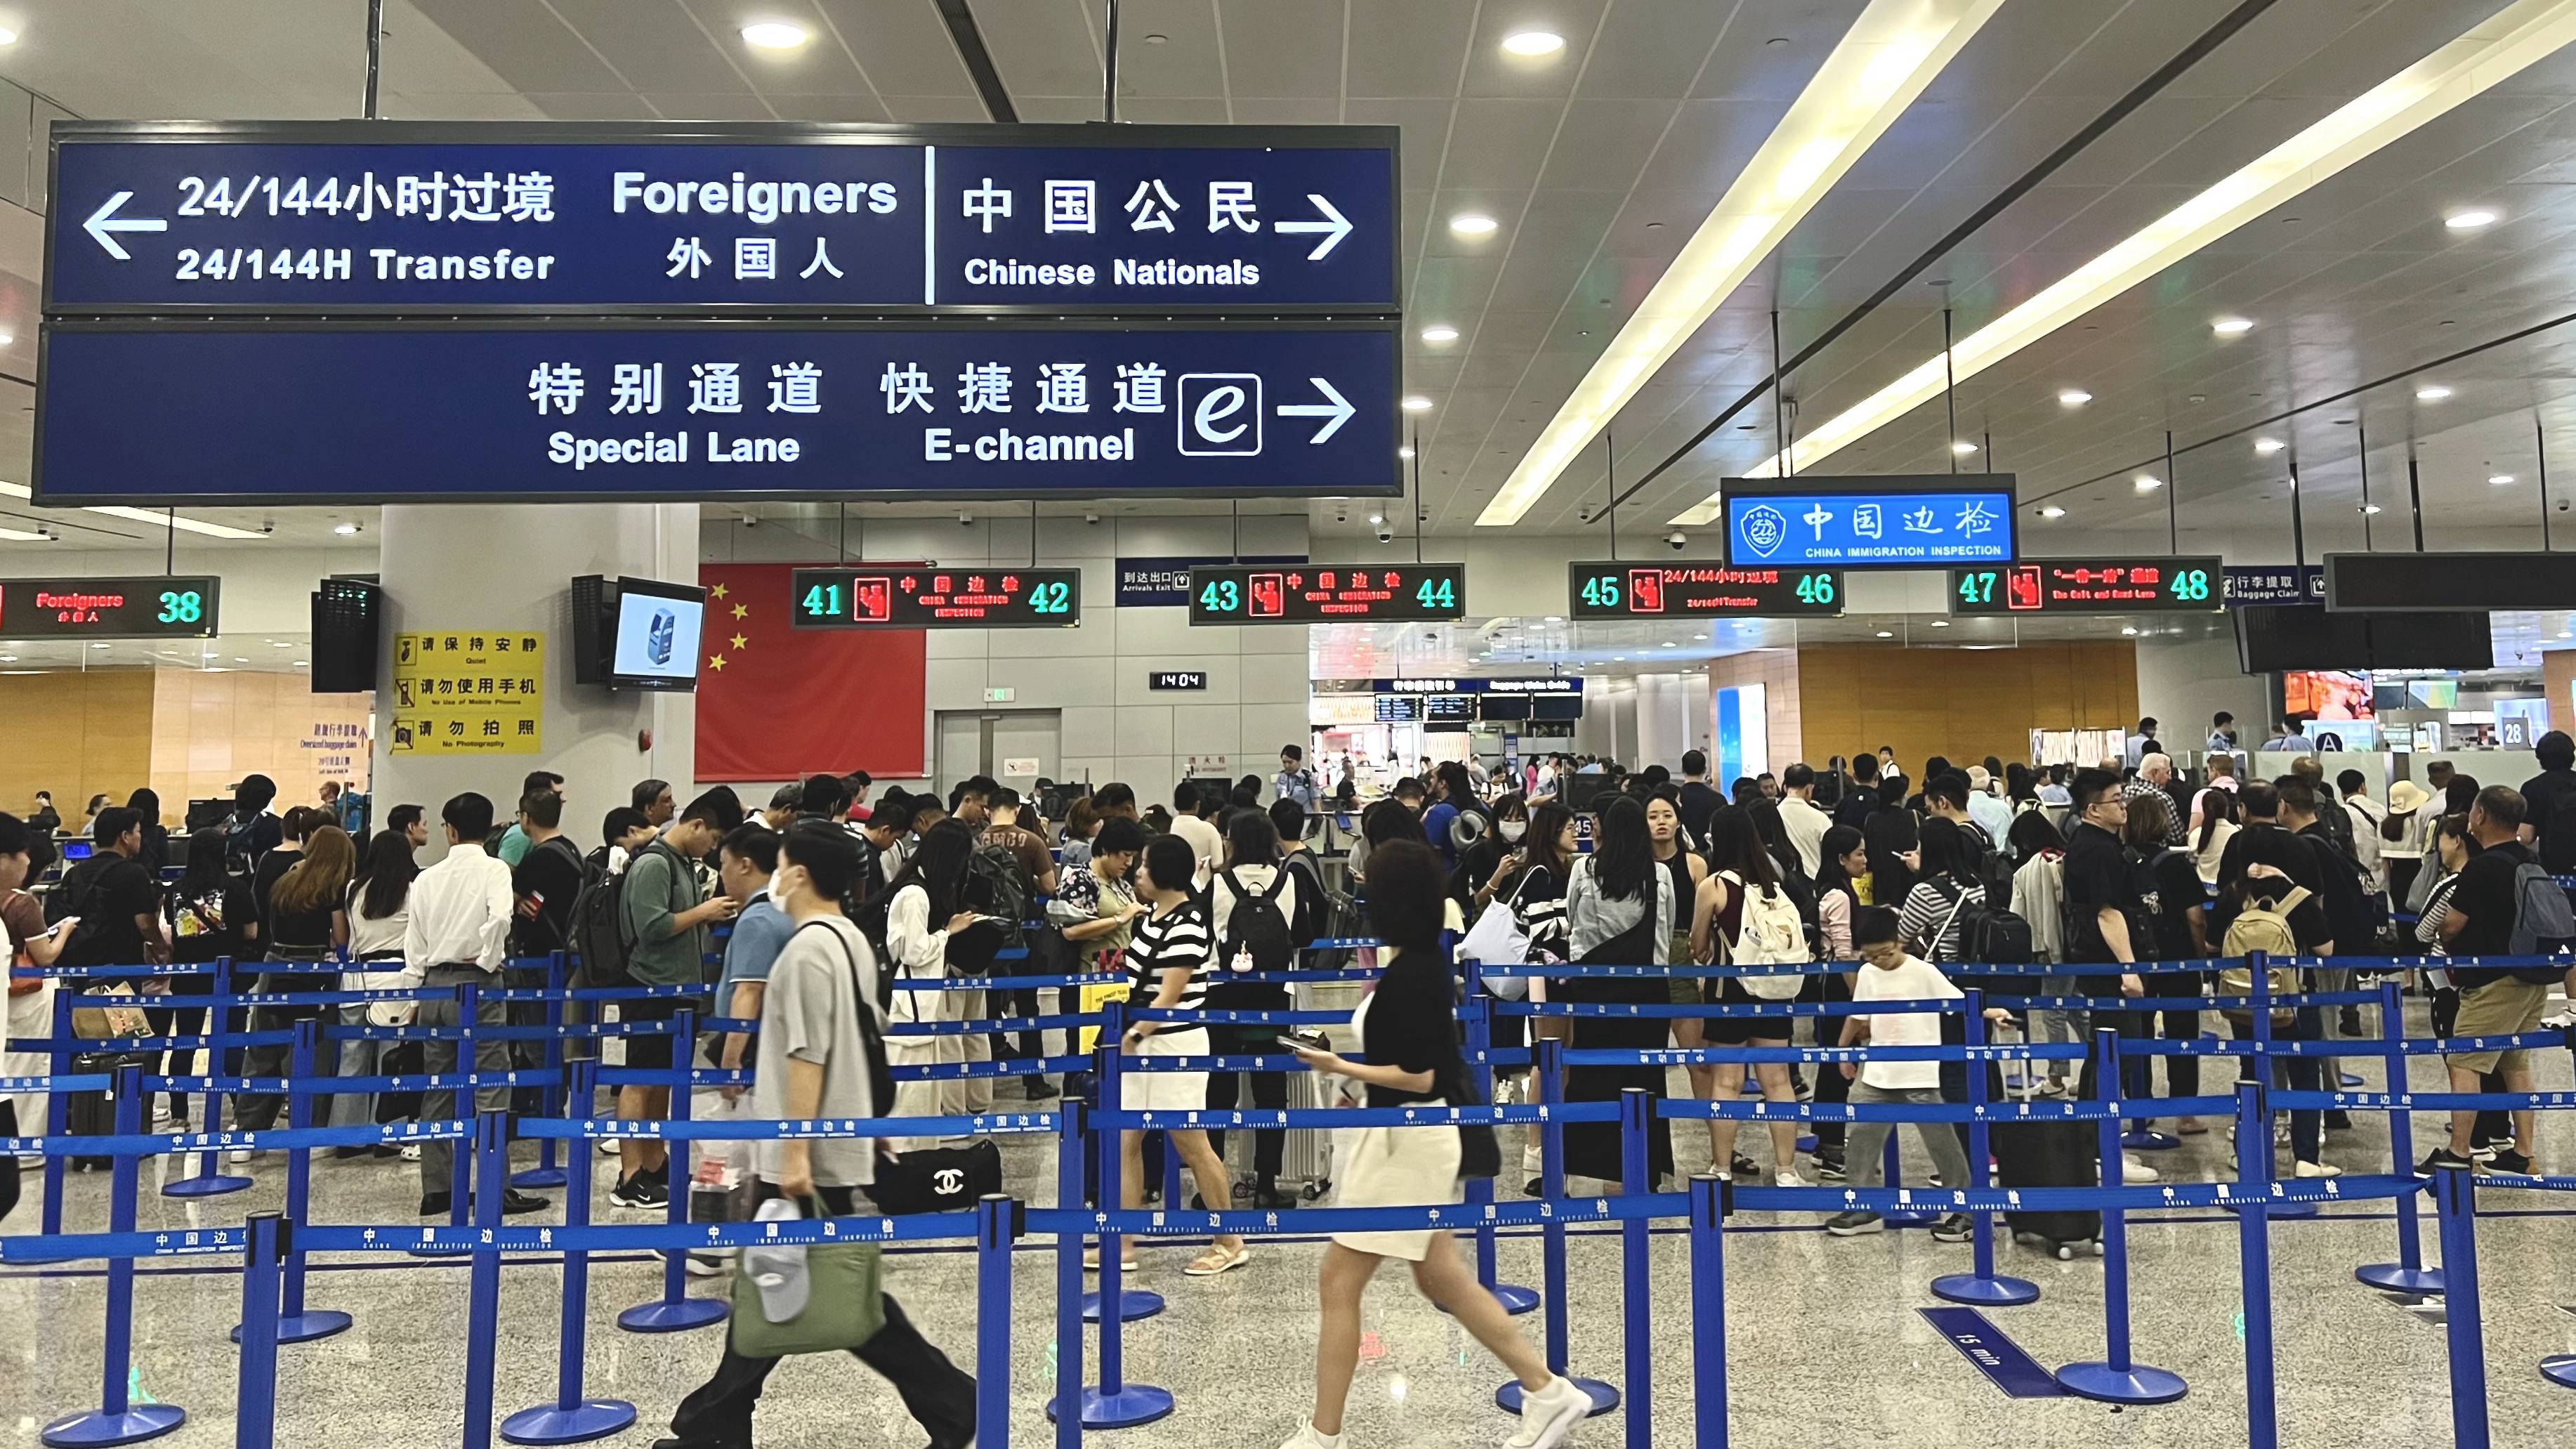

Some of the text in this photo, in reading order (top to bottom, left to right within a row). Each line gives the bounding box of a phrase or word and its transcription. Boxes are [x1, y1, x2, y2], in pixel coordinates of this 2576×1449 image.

[178, 171, 555, 222] 24/144小时过境
[614, 172, 897, 223] Foreigners
[964, 178, 1260, 233] 中国公民
[176, 249, 554, 280] 24/144H Transfer
[666, 237, 843, 280] 外国人
[965, 258, 1259, 284] Chinese Nationals
[529, 362, 822, 414] 特别通道
[880, 362, 1166, 414] 快捷通道
[548, 431, 799, 470] Special Lane
[926, 428, 1133, 461] E-channel
[1803, 501, 1999, 541] 中国边检
[1806, 546, 2001, 557] CHINA IMMIGRATION INSPECTION
[1124, 572, 1171, 583] 到达出口
[1582, 577, 1618, 606] 45
[1796, 574, 1833, 603] 46
[1959, 573, 1996, 602] 47
[2171, 570, 2208, 599] 48
[2237, 576, 2292, 588] 行李提取
[37, 593, 123, 612] Foreigners
[158, 591, 200, 622] 38
[803, 585, 841, 615] 41
[1029, 583, 1067, 612] 42
[1200, 581, 1238, 610] 43
[1417, 579, 1454, 607] 44
[2237, 591, 2274, 599] Baggage
[422, 636, 537, 653] 请保持安静
[421, 678, 536, 695] 请勿使用手机
[419, 719, 534, 737] 请勿拍照
[2505, 724, 2521, 743] 28
[2320, 733, 2339, 753] A
[2530, 1094, 2576, 1104] 中国
[1957, 1335, 2000, 1365] 15 min
